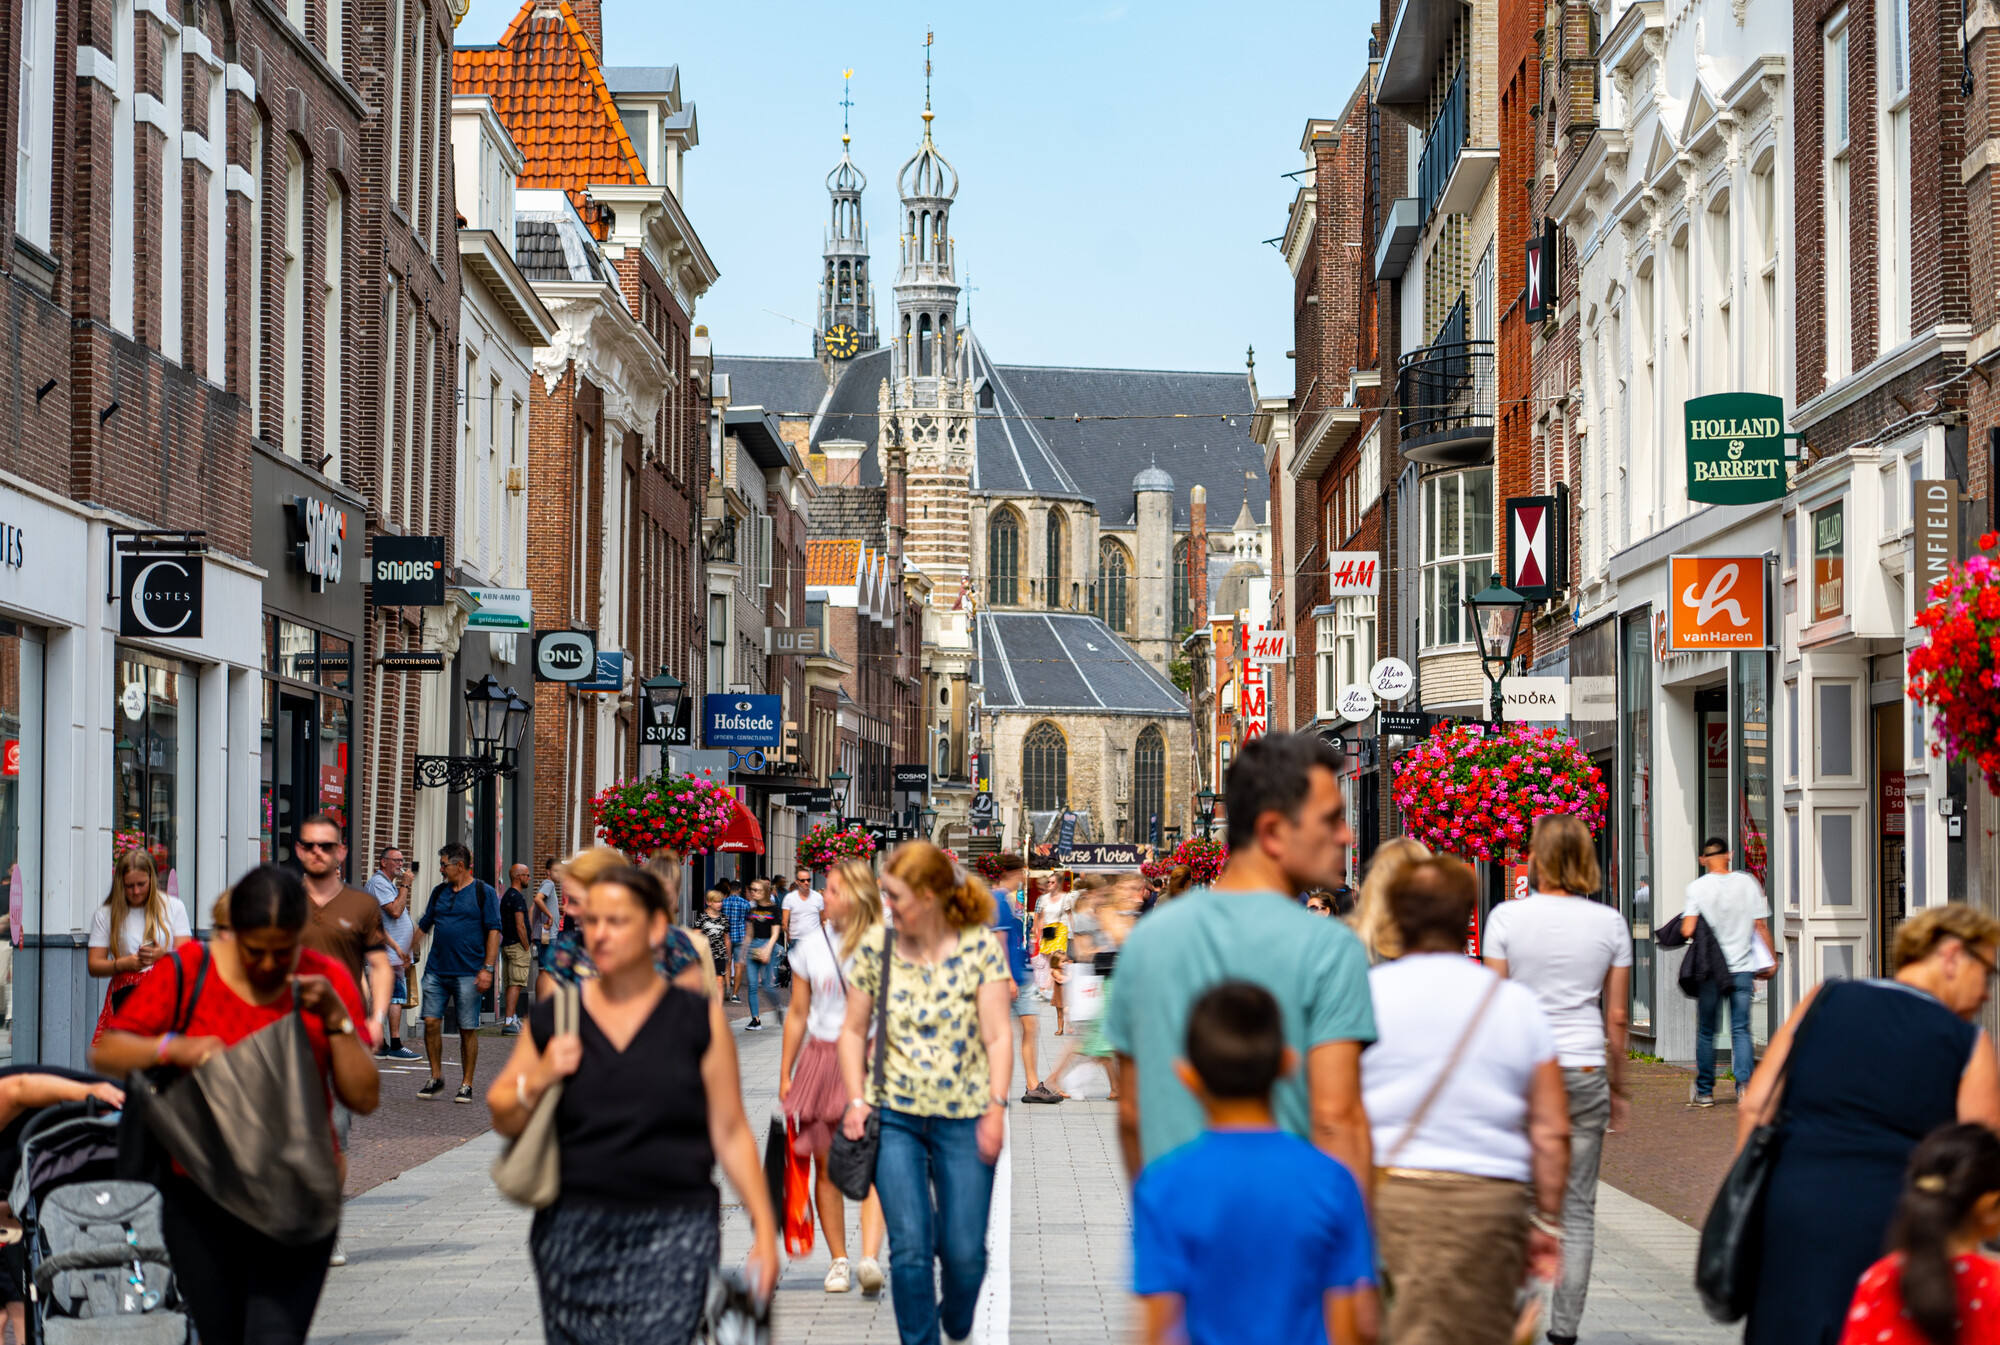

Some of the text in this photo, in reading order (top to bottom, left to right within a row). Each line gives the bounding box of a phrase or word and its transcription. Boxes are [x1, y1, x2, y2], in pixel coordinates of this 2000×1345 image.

[1691, 417, 1780, 441] HOLLAND
[1727, 440, 1744, 460] &
[1694, 458, 1779, 482] BARRETT
[1818, 513, 1841, 550] HOLLAND
[377, 561, 434, 584] snipes
[1334, 560, 1376, 588] H&M
[135, 592, 190, 601] COSTES
[1820, 577, 1841, 614] BARRETT
[478, 616, 519, 625] geldautomaat
[1682, 631, 1753, 642] vanHaren
[1253, 637, 1284, 657] H&M
[541, 650, 589, 663] ONLY
[1376, 666, 1404, 680] Miss
[1378, 678, 1408, 691] Etam
[1343, 691, 1367, 703] Miss
[1501, 691, 1556, 705] ANDORA
[1343, 702, 1369, 713] Etam
[714, 714, 773, 730] Hofstede
[1381, 717, 1421, 725] DISTRIKT
[646, 727, 686, 741] SONS
[1094, 846, 1135, 863] Noten
